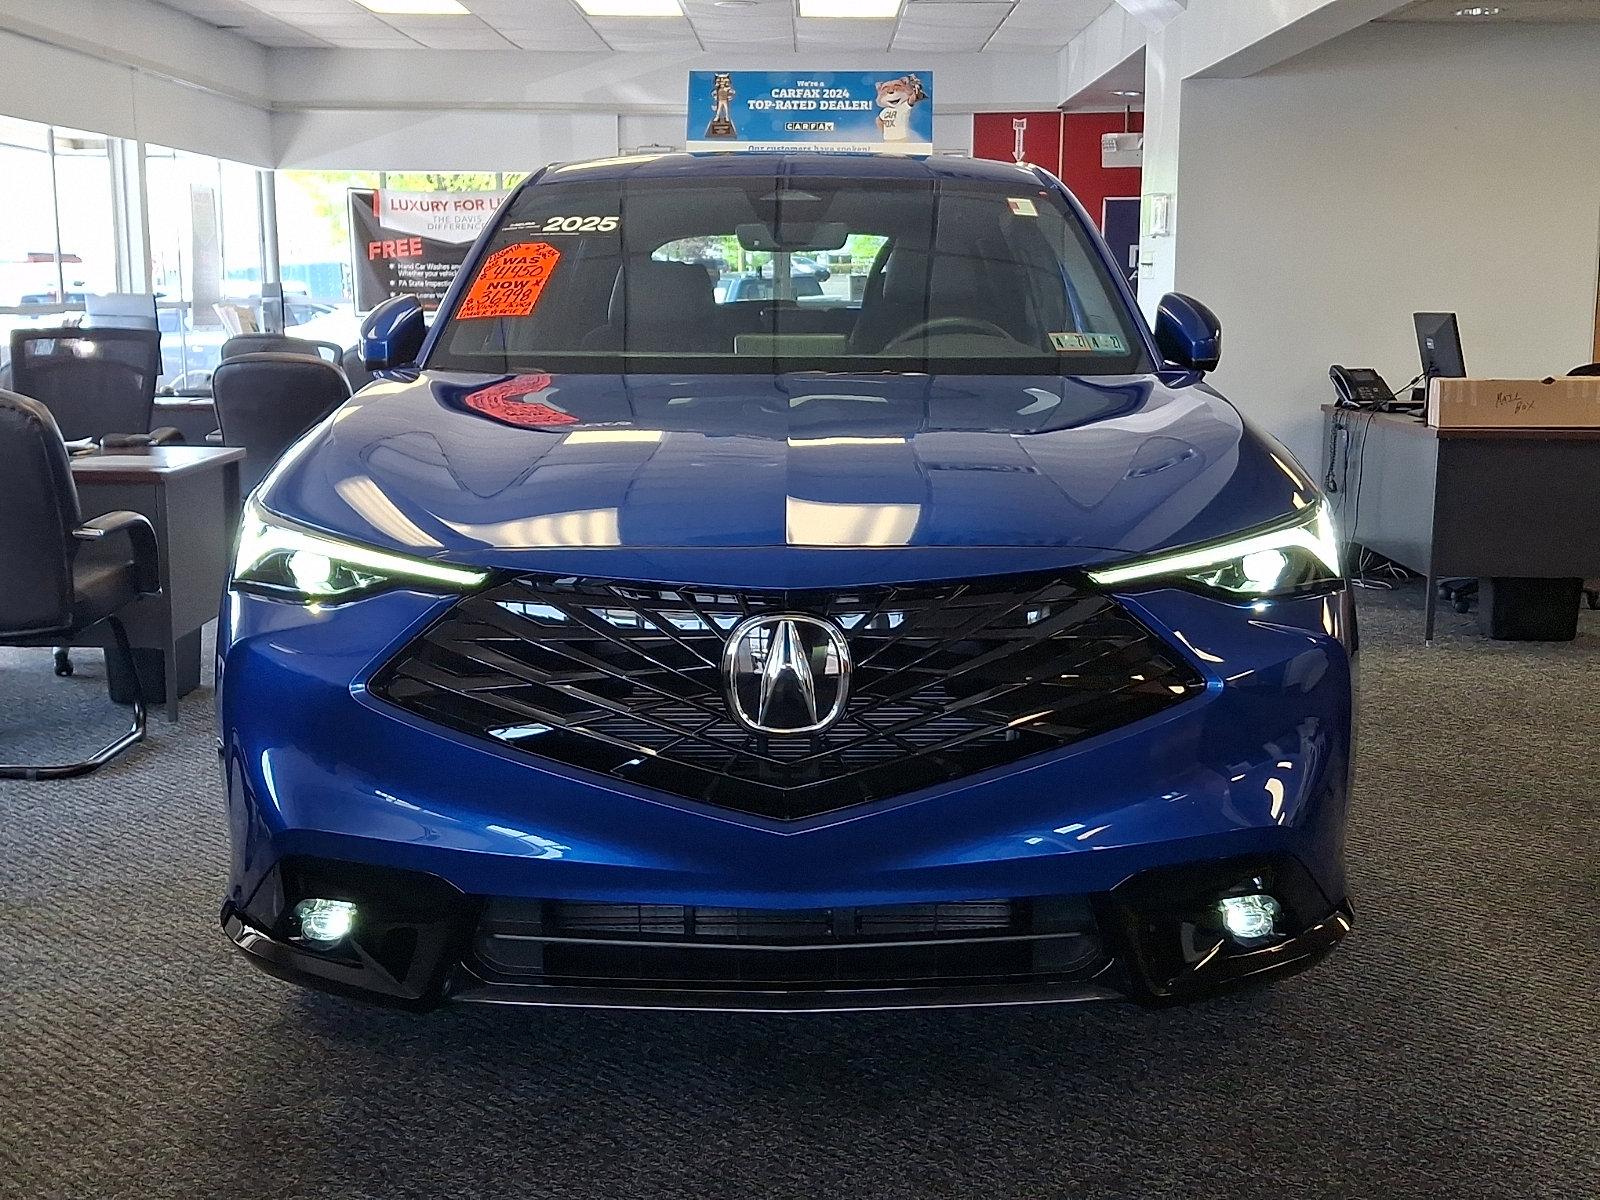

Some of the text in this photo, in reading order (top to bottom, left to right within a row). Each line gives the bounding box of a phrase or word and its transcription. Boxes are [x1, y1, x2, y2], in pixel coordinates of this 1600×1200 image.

[771, 88, 850, 98] CARFAX 2024
[748, 100, 873, 110] TOP-RATED DEALER!
[785, 122, 834, 131] CARFAX
[390, 198, 449, 212] LUXURY
[454, 199, 485, 211] FOR
[433, 215, 482, 223] THE DAVIS
[541, 216, 620, 232] 2025
[368, 237, 423, 260] FREE
[503, 257, 540, 265] WAS
[494, 265, 543, 279] 41450
[486, 280, 529, 289] NOW
[481, 288, 533, 304] 36998
